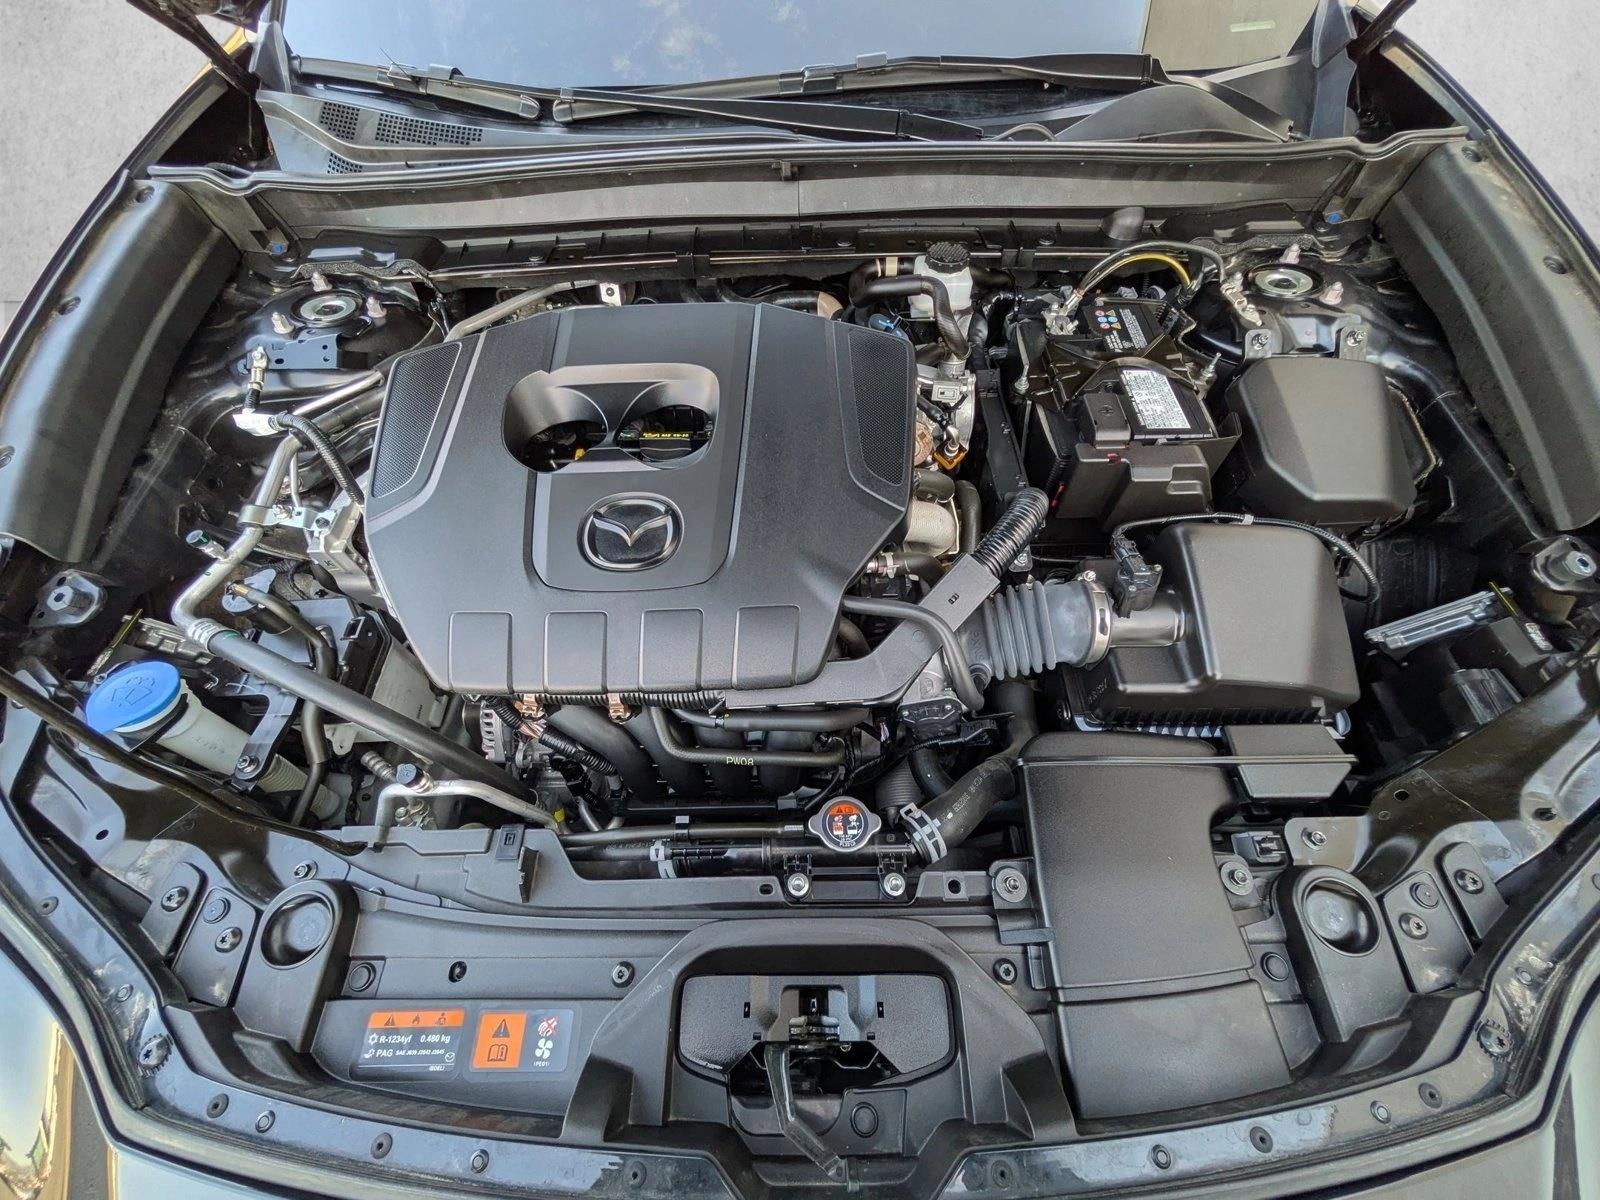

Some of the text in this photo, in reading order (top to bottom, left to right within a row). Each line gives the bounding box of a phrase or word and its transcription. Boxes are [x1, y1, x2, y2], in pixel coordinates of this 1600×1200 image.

[379, 1034, 451, 1045] R-1234yf 0.480 kg
[376, 1049, 393, 1057] PAG
